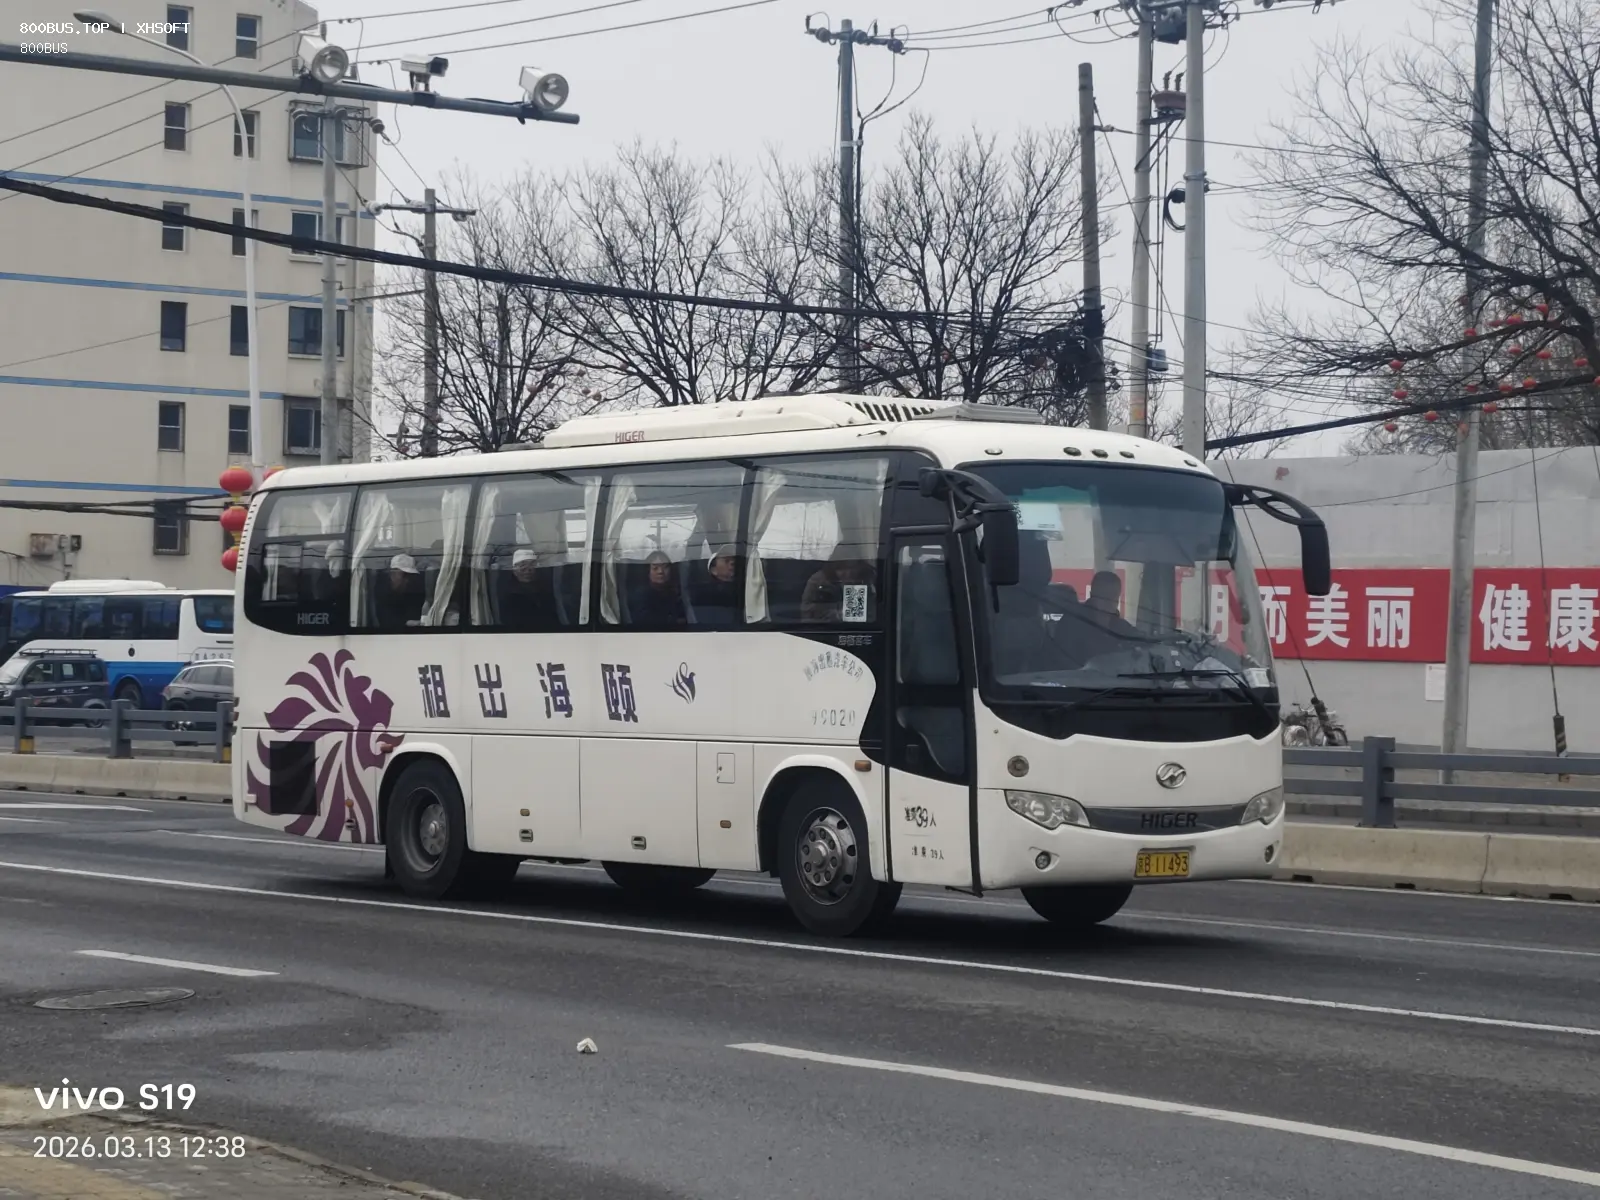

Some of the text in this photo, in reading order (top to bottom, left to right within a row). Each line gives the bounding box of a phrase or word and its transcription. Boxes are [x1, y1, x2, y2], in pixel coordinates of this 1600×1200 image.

[614, 430, 645, 443] HIGER
[297, 612, 330, 625] HIGER
[1478, 583, 1600, 652] 健康
[1141, 812, 1199, 829] HIGER
